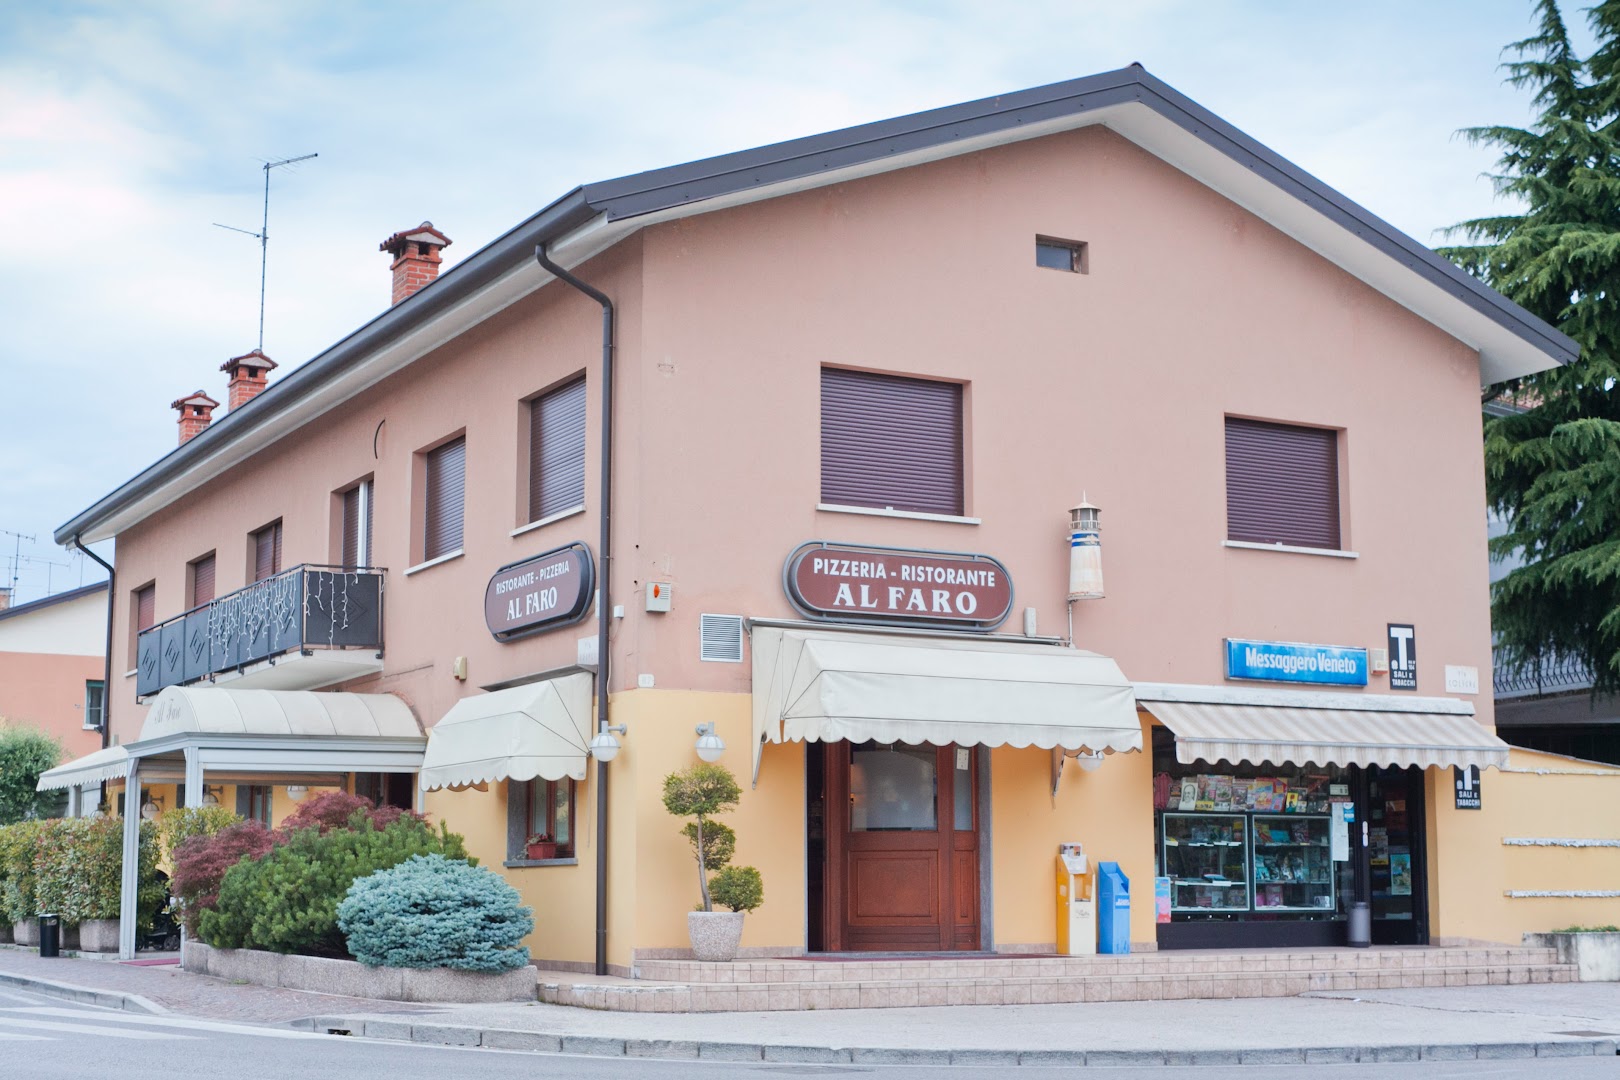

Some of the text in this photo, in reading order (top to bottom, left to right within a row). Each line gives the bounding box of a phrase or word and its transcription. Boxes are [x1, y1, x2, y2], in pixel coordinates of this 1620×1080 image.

[496, 572, 534, 595] RISTORANTE
[540, 560, 570, 581] PIZZERIA
[813, 557, 887, 580] PIZZERIA
[901, 564, 995, 587] RISTORANTE
[506, 586, 558, 621] AL FARO
[833, 583, 977, 615] AL FARO
[1245, 646, 1357, 675] Messaggero Veneto
[1390, 627, 1414, 671] T
[1392, 678, 1415, 687] TABACCHI
[1393, 670, 1408, 678] SALI
[1457, 798, 1480, 806] TABACCHI
[1458, 790, 1473, 798] SALI
